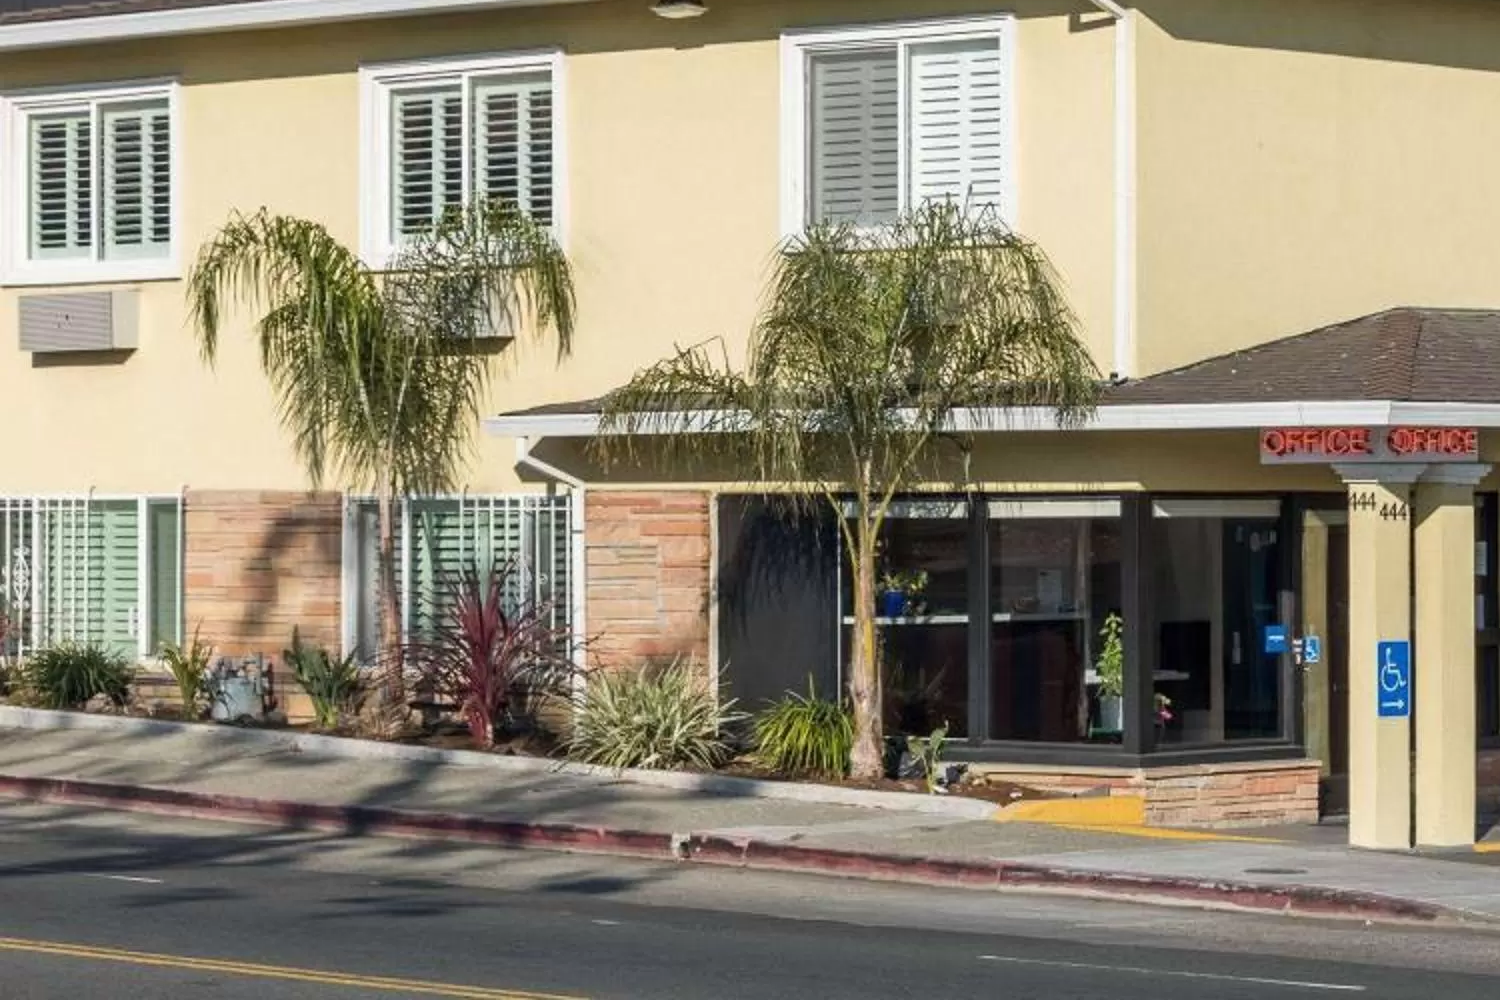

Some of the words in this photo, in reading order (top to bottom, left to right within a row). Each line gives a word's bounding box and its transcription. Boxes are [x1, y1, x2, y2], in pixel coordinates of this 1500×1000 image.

[1263, 428, 1373, 456] OFFICE
[1387, 427, 1478, 456] OFFICE
[1350, 491, 1376, 512] 444
[1379, 501, 1407, 521] 444
